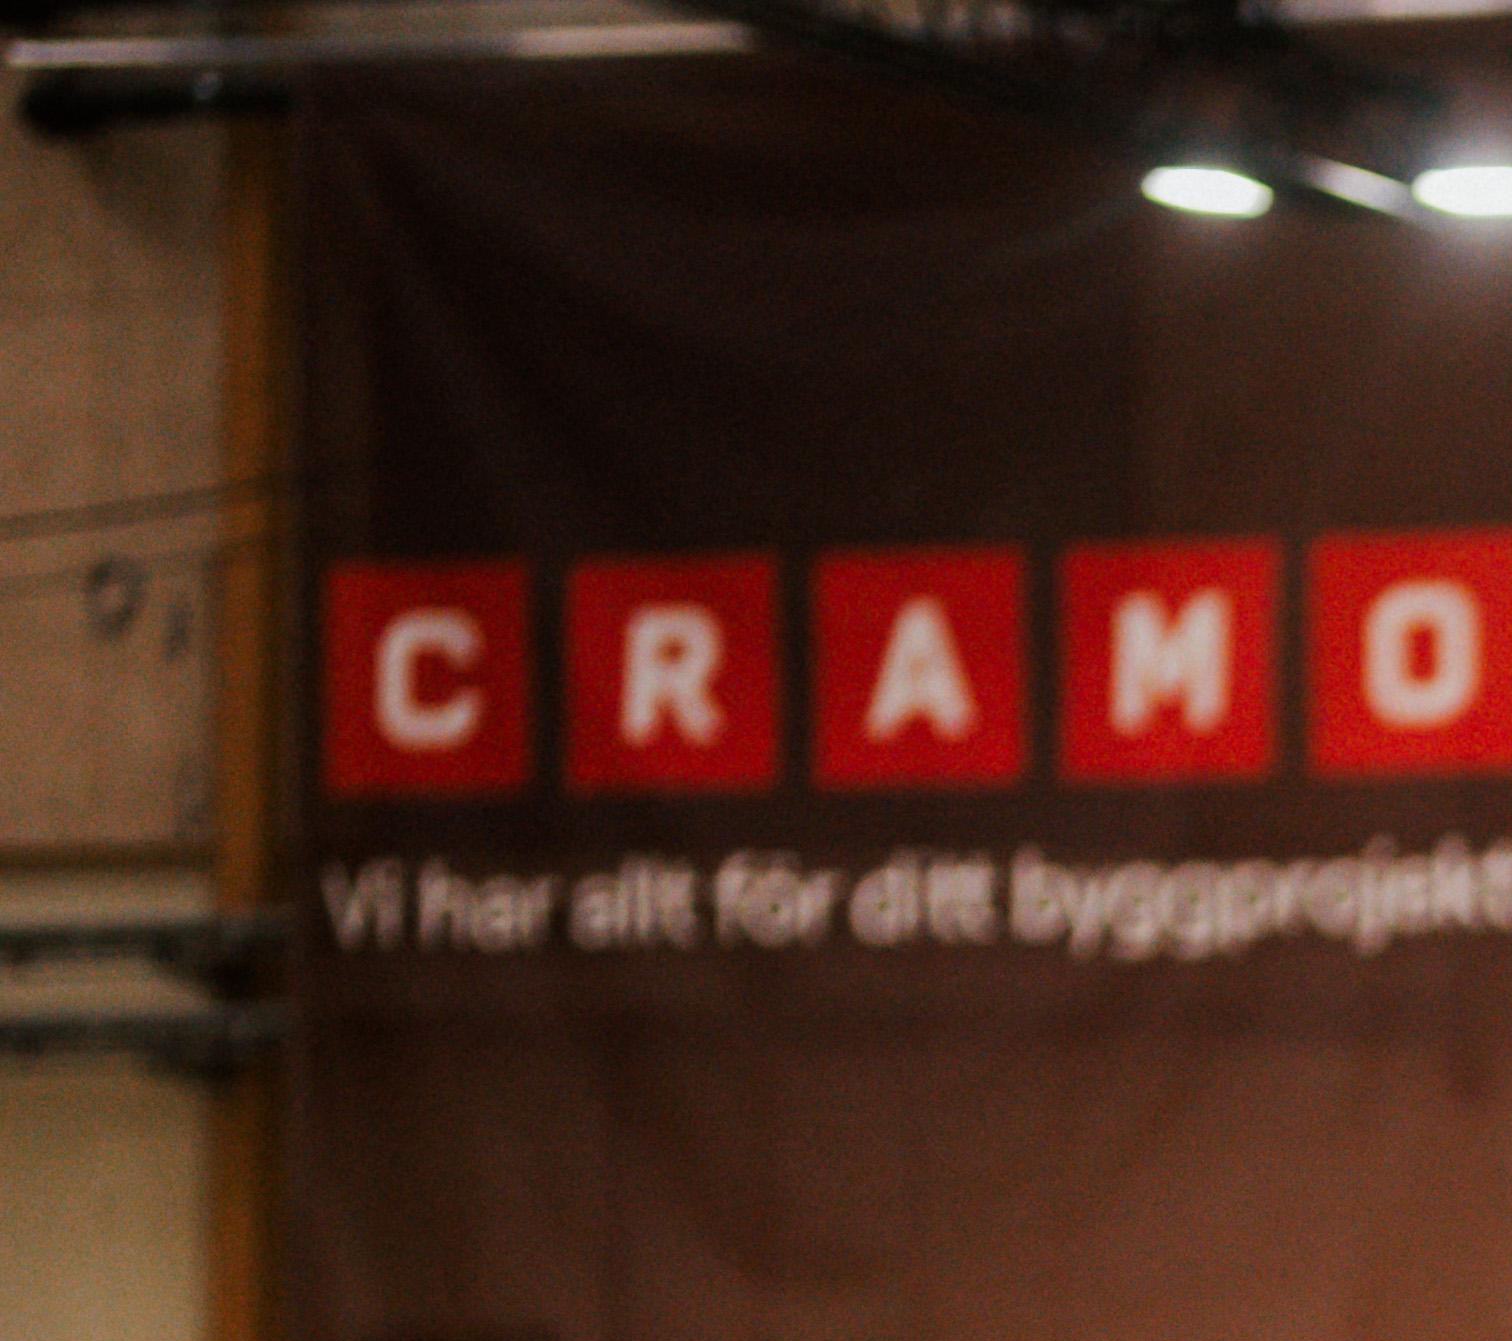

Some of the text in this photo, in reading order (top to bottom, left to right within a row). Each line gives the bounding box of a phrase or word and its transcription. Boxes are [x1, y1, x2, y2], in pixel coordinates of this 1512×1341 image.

[374, 582, 1480, 742] CRAMO
[322, 866, 398, 946] Vi
[420, 858, 555, 945] har
[570, 858, 700, 940] allt
[714, 850, 840, 944] för
[850, 855, 997, 946] ditt
